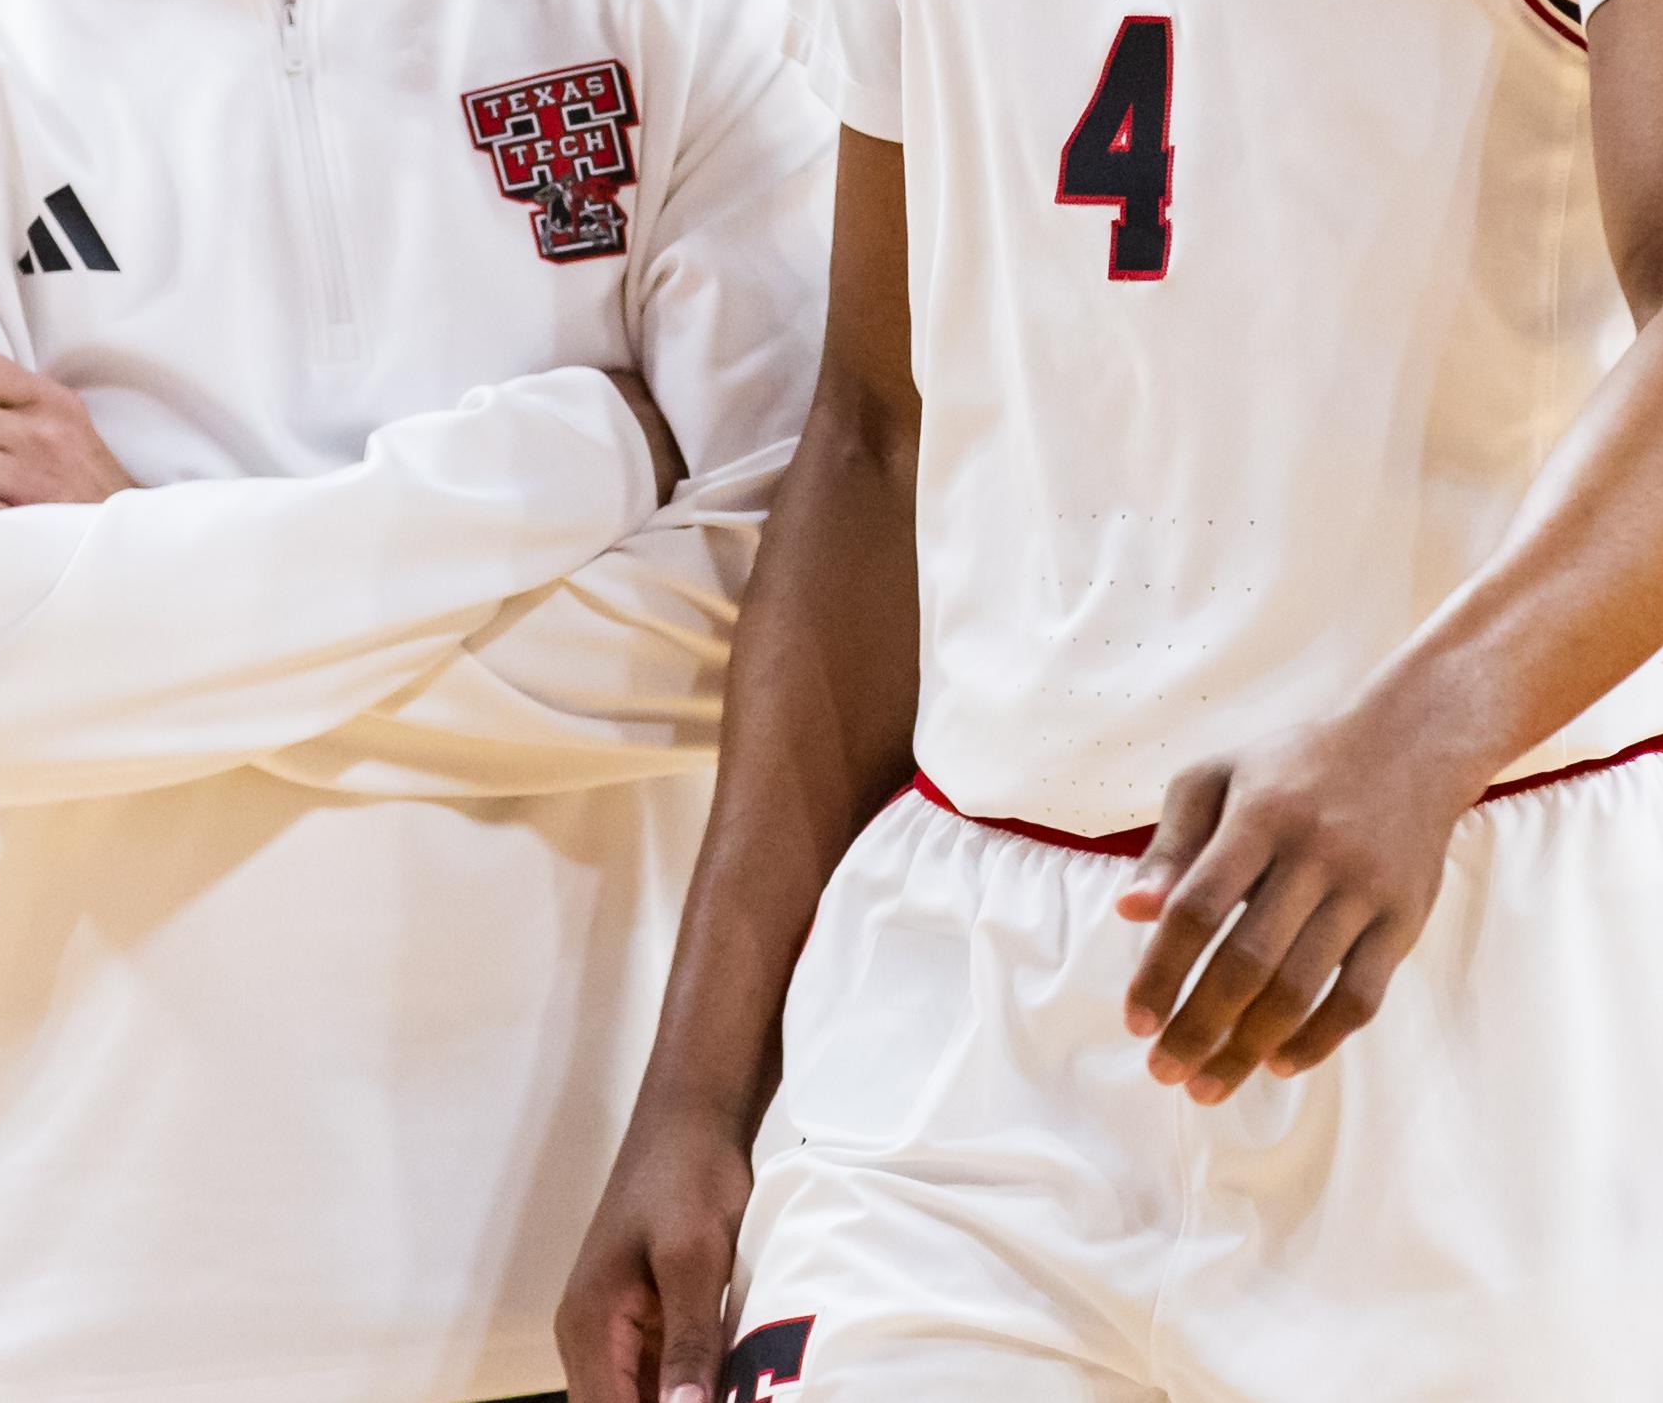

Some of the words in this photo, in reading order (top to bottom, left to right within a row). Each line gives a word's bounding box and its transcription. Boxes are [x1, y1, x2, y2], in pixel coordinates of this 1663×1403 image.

[484, 75, 606, 119] TEXAS
[510, 130, 606, 166] TECH
[1054, 15, 1176, 281] 4
